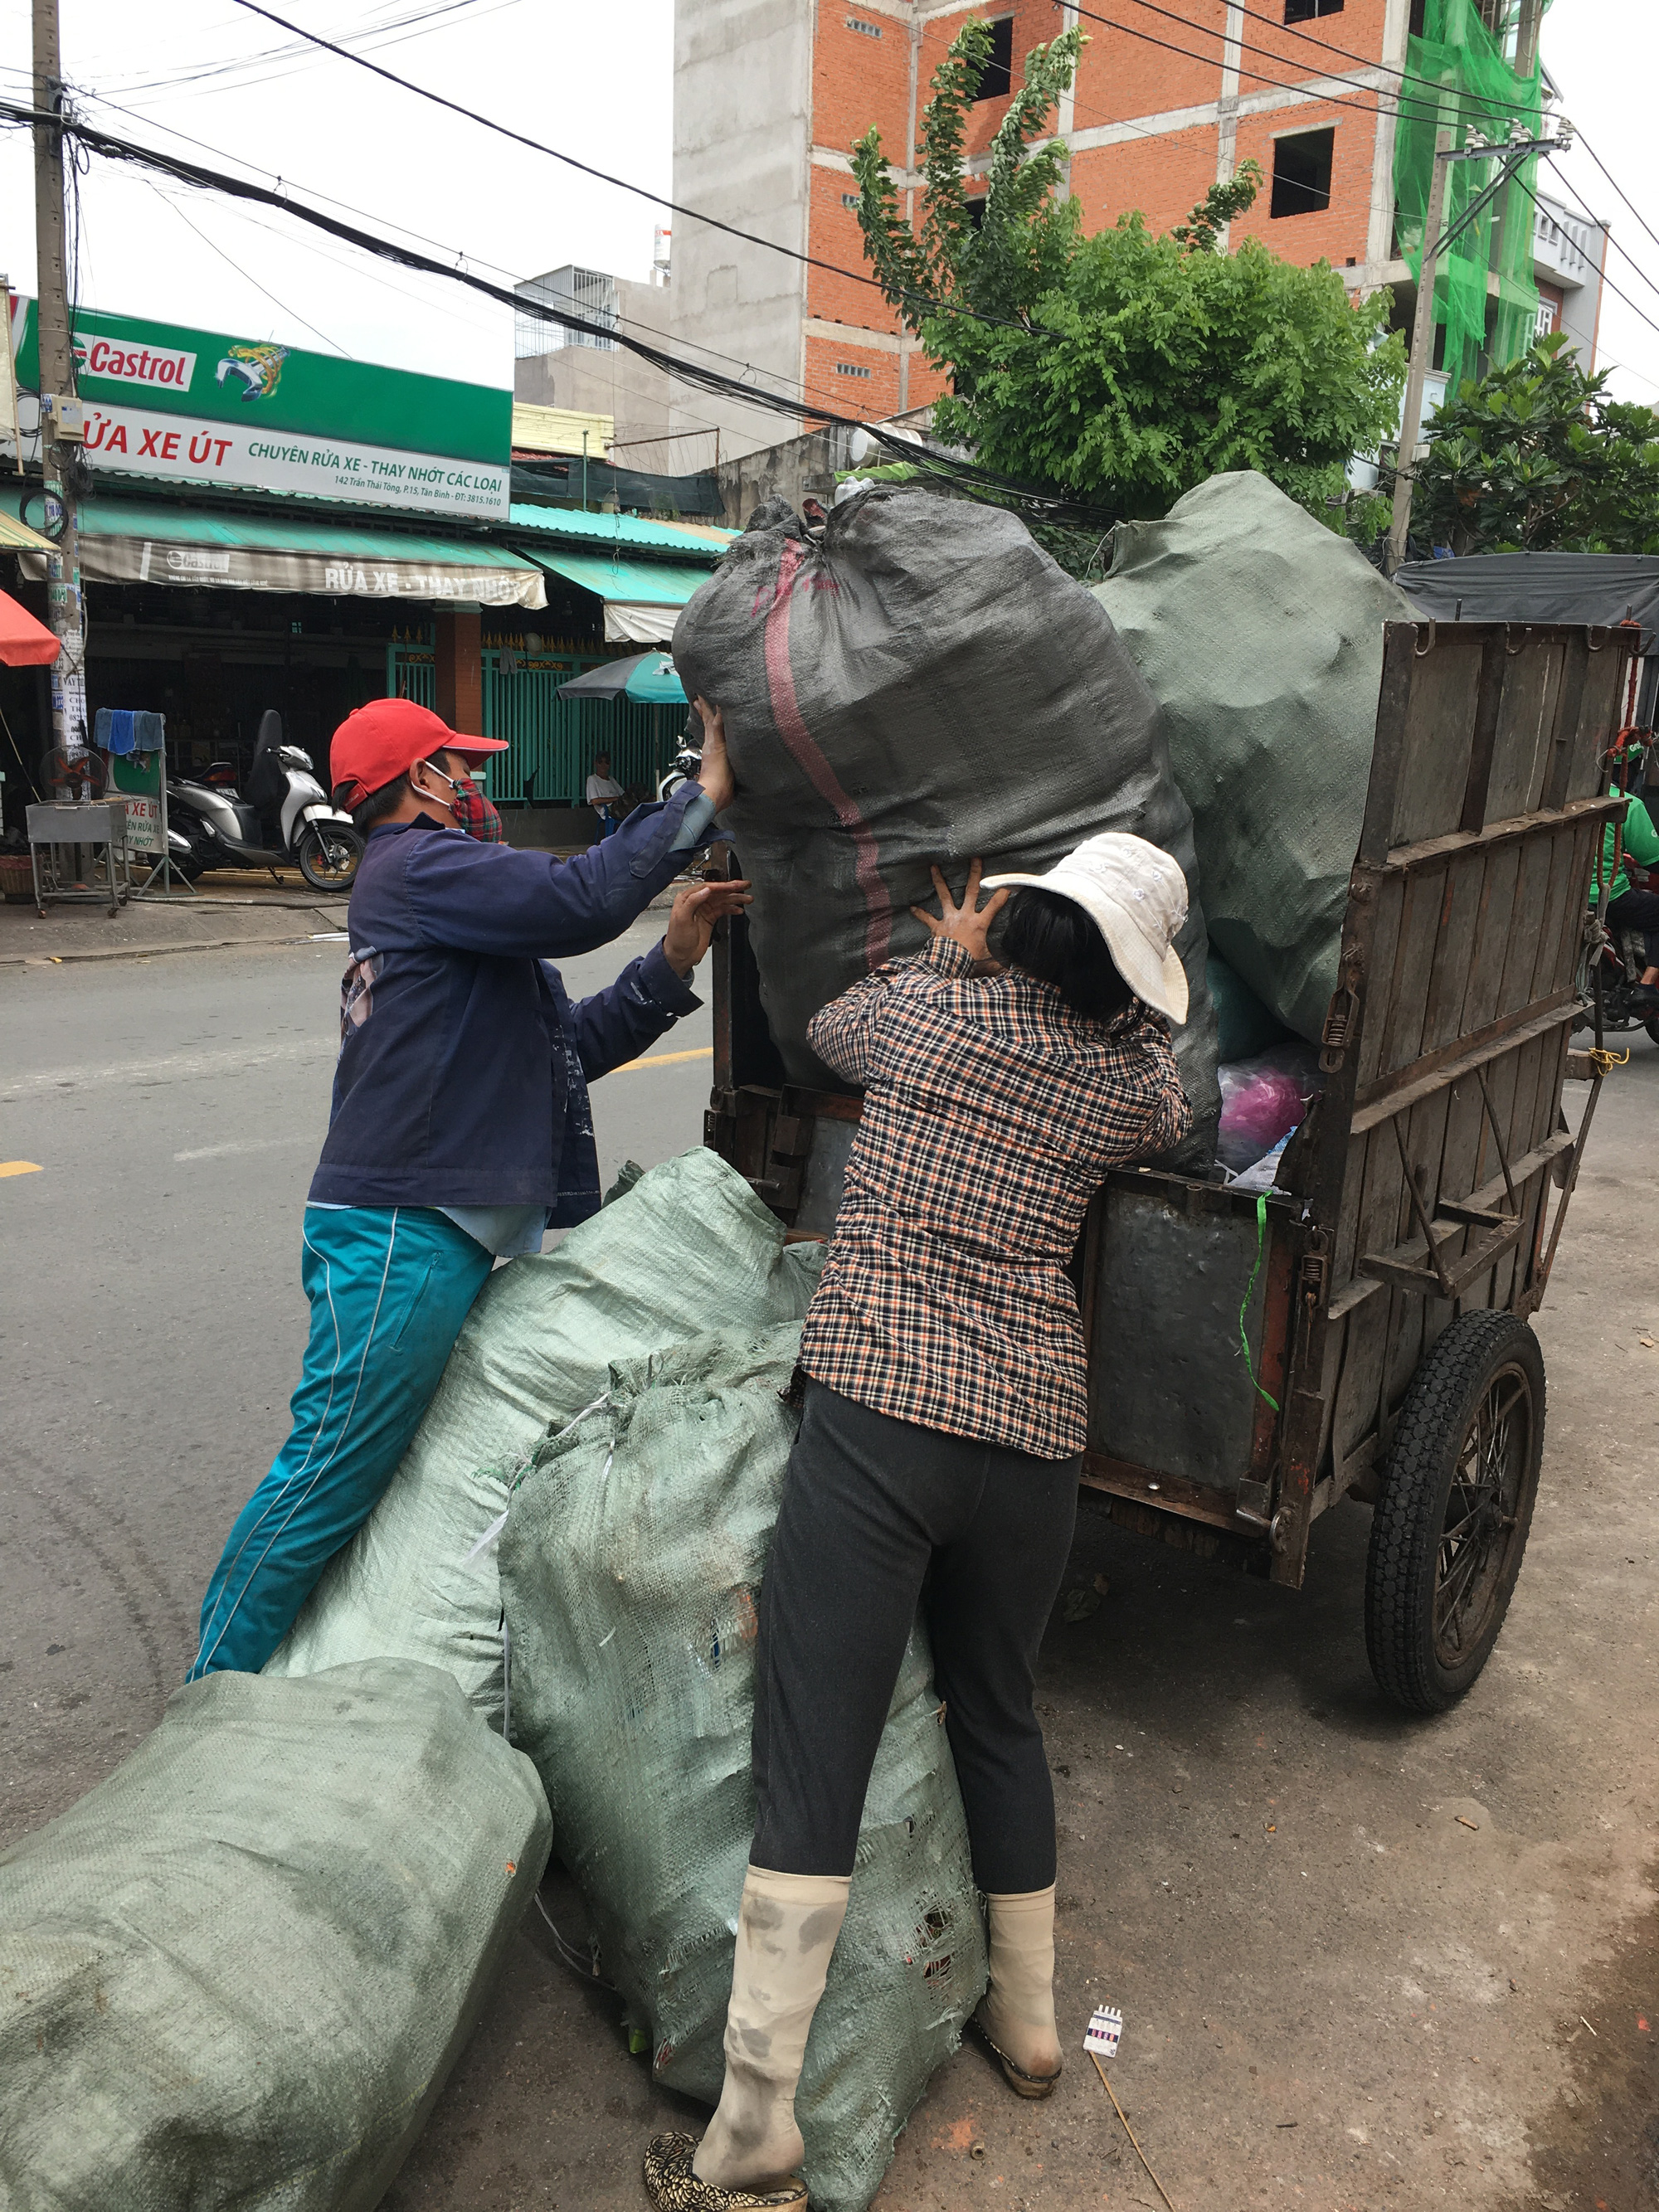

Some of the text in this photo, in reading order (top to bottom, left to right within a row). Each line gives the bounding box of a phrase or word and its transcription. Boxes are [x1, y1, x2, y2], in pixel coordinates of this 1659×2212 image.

[90, 342, 186, 386] Castrol
[82, 412, 233, 466] ỬA XE ÚT
[249, 442, 309, 464] CHUYÊN
[311, 449, 339, 469] RỬA
[343, 456, 361, 472] XE
[372, 460, 406, 478] THAY
[408, 466, 445, 484] NHỚT
[446, 470, 472, 488] CÁC
[474, 476, 502, 494] LOẠI
[335, 475, 348, 485] 142
[367, 479, 382, 489] Thái
[421, 488, 433, 497] Tân
[467, 493, 501, 507] 3815.1610
[324, 562, 367, 591] RỬA
[373, 571, 399, 593] XE
[412, 576, 465, 596] THAY
[132, 802, 146, 817] XE
[134, 835, 154, 847] NHỚT
[138, 820, 152, 833] RỬA
[153, 824, 159, 834] XE
